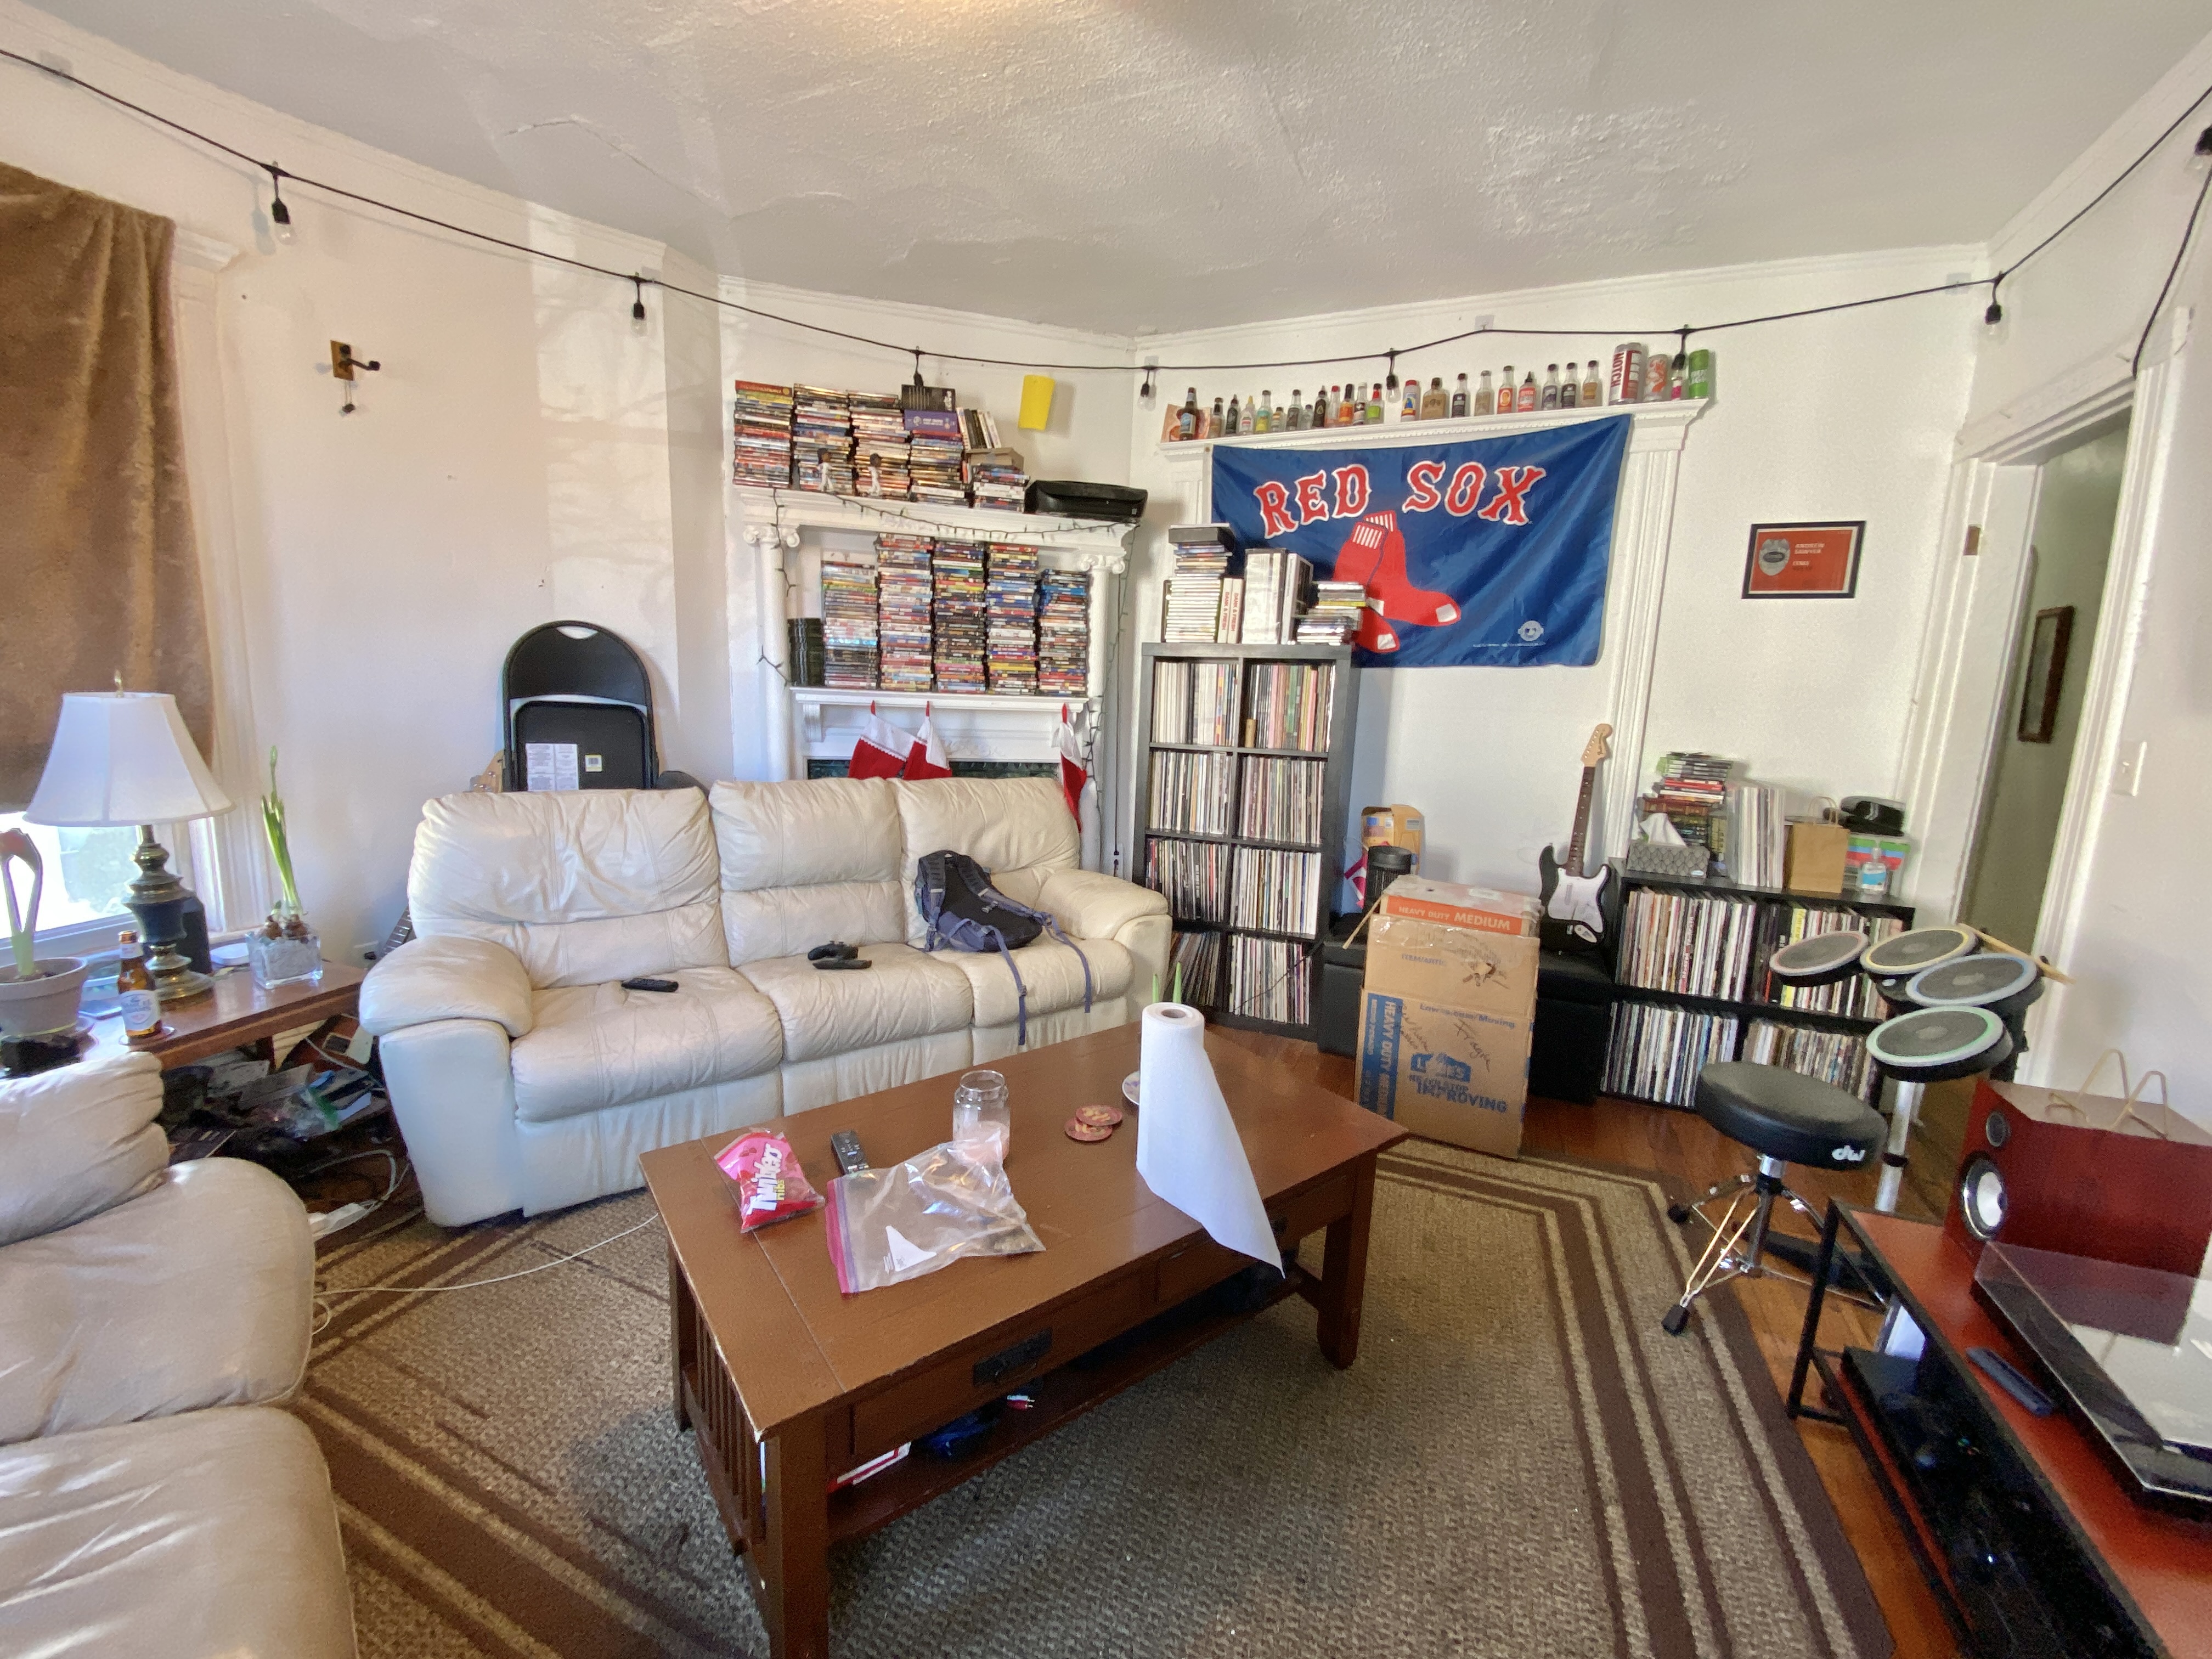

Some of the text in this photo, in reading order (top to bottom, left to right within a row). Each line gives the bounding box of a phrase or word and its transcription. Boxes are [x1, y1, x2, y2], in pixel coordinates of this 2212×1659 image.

[1611, 352, 1624, 388] NOTCH
[1253, 460, 1547, 539] RED SOX
[1398, 906, 1510, 931] HEAVY DUTY MEDIUM
[1383, 1000, 1396, 1040] HEAVY
[1380, 1040, 1393, 1072] DUTY
[773, 1180, 786, 1201] nibs
